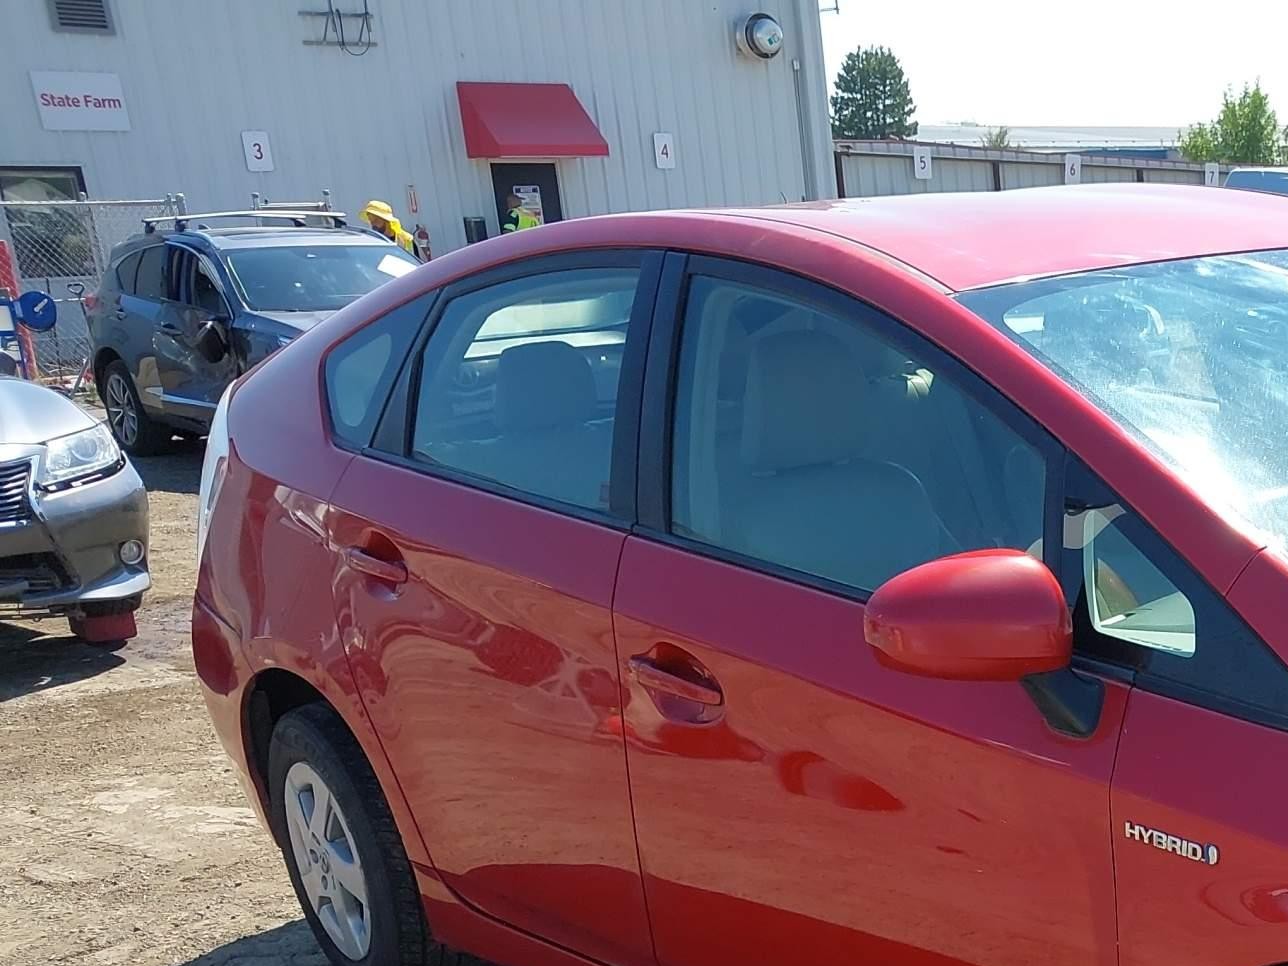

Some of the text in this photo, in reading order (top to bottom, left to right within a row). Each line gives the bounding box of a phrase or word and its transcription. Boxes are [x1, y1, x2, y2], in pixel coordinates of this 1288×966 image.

[40, 93, 122, 109] State Farm
[253, 143, 263, 160] 3
[661, 143, 669, 159] 4
[919, 155, 926, 170] 5
[1070, 163, 1076, 176] 6
[1209, 170, 1215, 183] 7
[1124, 821, 1203, 861] HYBRID
